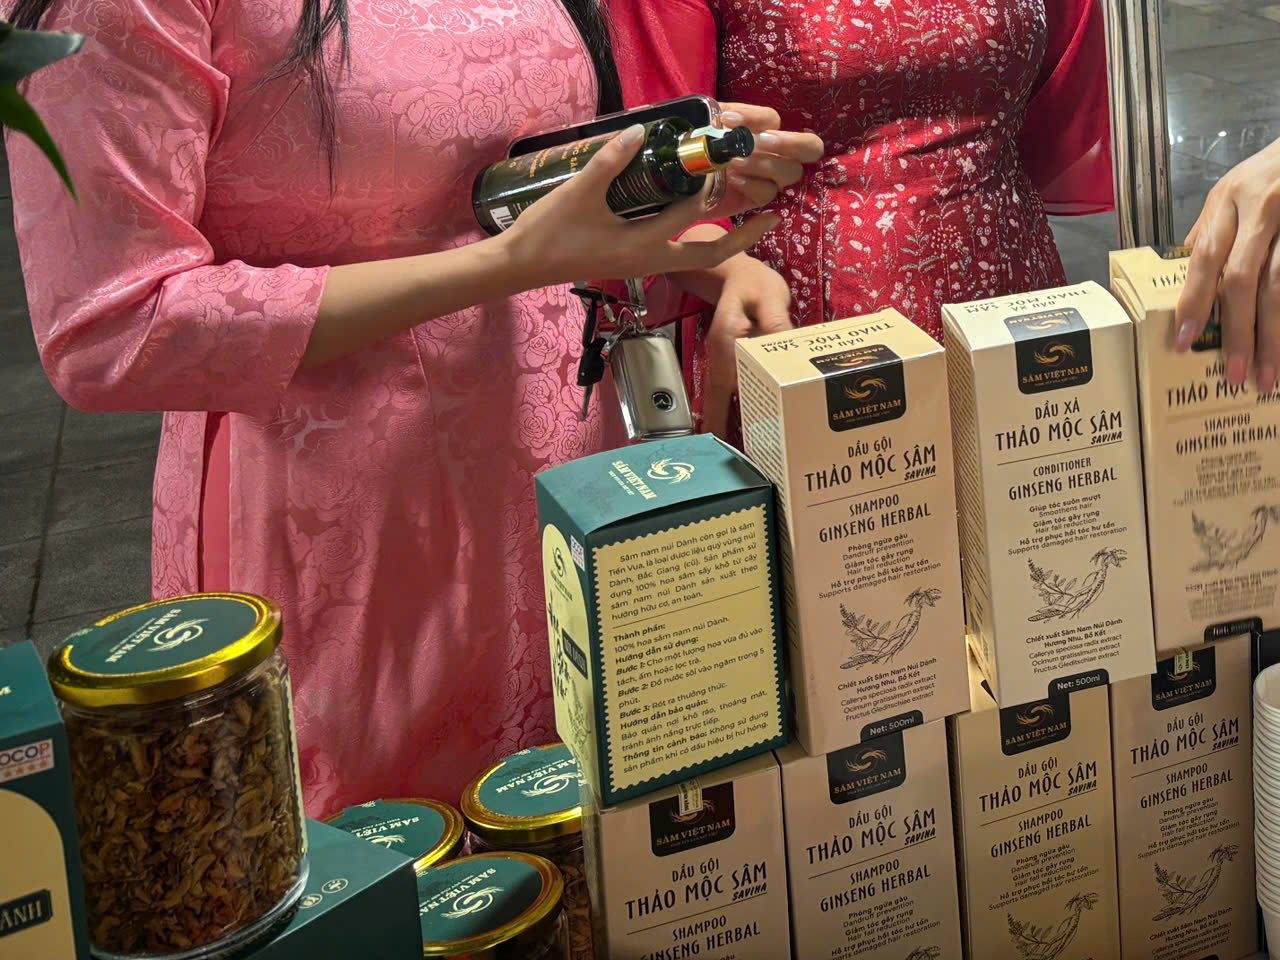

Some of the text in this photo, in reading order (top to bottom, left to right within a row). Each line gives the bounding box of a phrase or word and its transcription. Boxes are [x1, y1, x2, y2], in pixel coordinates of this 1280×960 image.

[1022, 365, 1088, 384] SÂM VIỆT NAM
[832, 399, 902, 421] SÂM VIỆT NAM
[1035, 397, 1080, 420] DẦU XẢ
[995, 409, 1122, 451] THẢO MỘC SÂM
[1091, 431, 1122, 445] SAVINA
[848, 436, 892, 458] DẦU GỘI
[805, 444, 936, 492] THẢO MỘC SÂM
[904, 465, 936, 481] SAVINA
[1033, 457, 1091, 477] CONDITIONER
[1009, 467, 1118, 501] GINSENG HERBAL
[849, 494, 899, 517] SHAMPOO
[1029, 493, 1101, 514] Giúp tóc suôn mượt
[819, 503, 931, 543] GINSENG HERBAL
[613, 623, 666, 643] Thành phần:
[615, 642, 635, 654] 100%
[637, 638, 652, 648] hoa
[654, 633, 671, 643] sâm
[673, 628, 691, 638] nam
[692, 622, 706, 633] núi
[615, 637, 700, 665] Hướng dẫn sử dụng:
[1057, 674, 1101, 691] Net: 500ml
[869, 716, 914, 736] Net: 500ml
[623, 730, 708, 763] Thông tin cảnh báo:
[1018, 756, 1058, 779] DẦU GỘI
[979, 760, 1097, 812] THẢO MỘC SÂM
[1068, 780, 1097, 796] SAVINA
[1018, 808, 1064, 833] SHAMPOO
[991, 814, 1092, 858] GINSENG HERBAL
